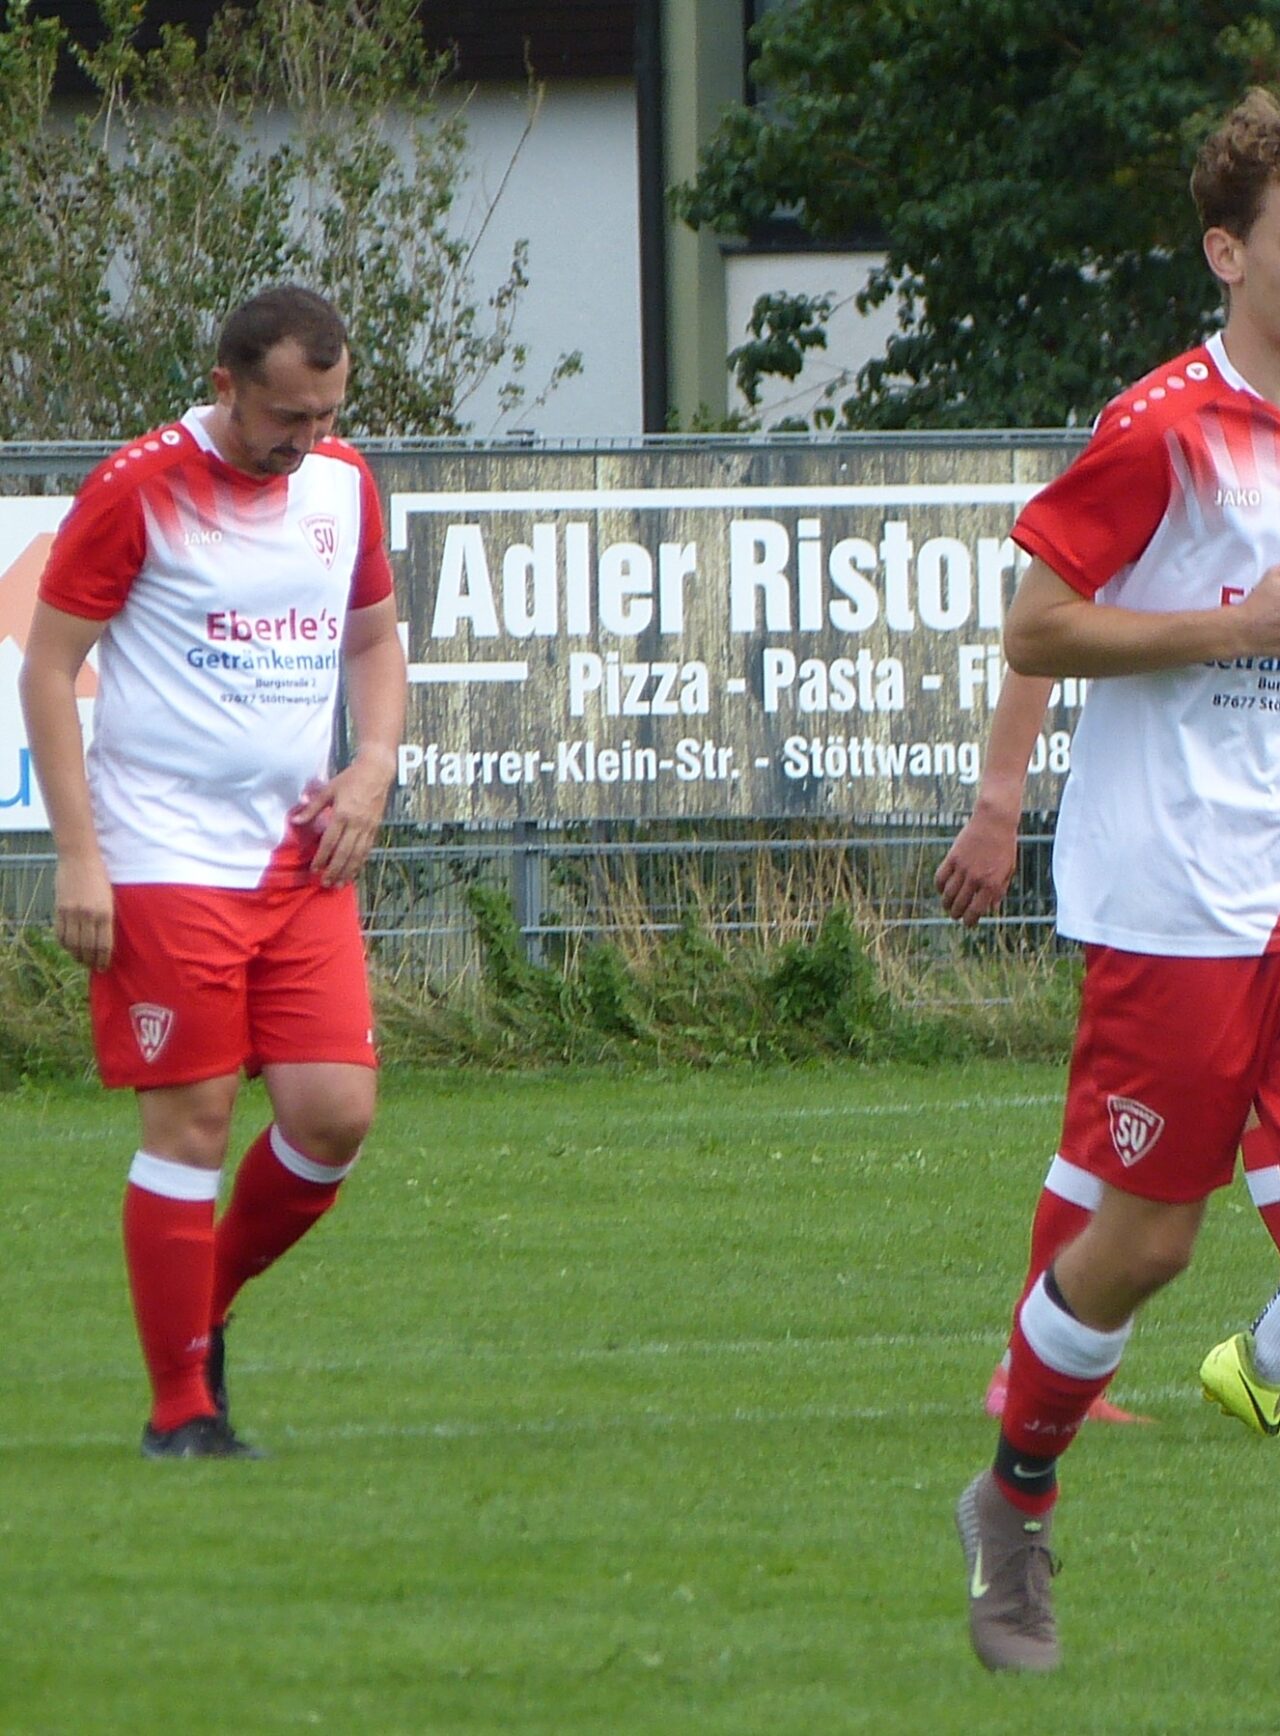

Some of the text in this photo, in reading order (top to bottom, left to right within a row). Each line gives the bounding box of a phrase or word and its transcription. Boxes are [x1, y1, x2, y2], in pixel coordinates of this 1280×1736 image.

[1215, 488, 1261, 507] JAKO
[183, 529, 223, 546] JAKO
[313, 527, 334, 554] SV
[431, 517, 1032, 639] Adler Ristor
[206, 607, 338, 641] Eberle's
[569, 652, 709, 717] Pizza
[726, 677, 746, 693] -
[763, 647, 904, 712] Pasta
[921, 674, 943, 690] -
[1212, 694, 1256, 709] 87677
[397, 739, 740, 786] Pfarrer-Klein-Str.
[784, 736, 980, 784] Stöttwang
[1116, 1111, 1148, 1152] SV
